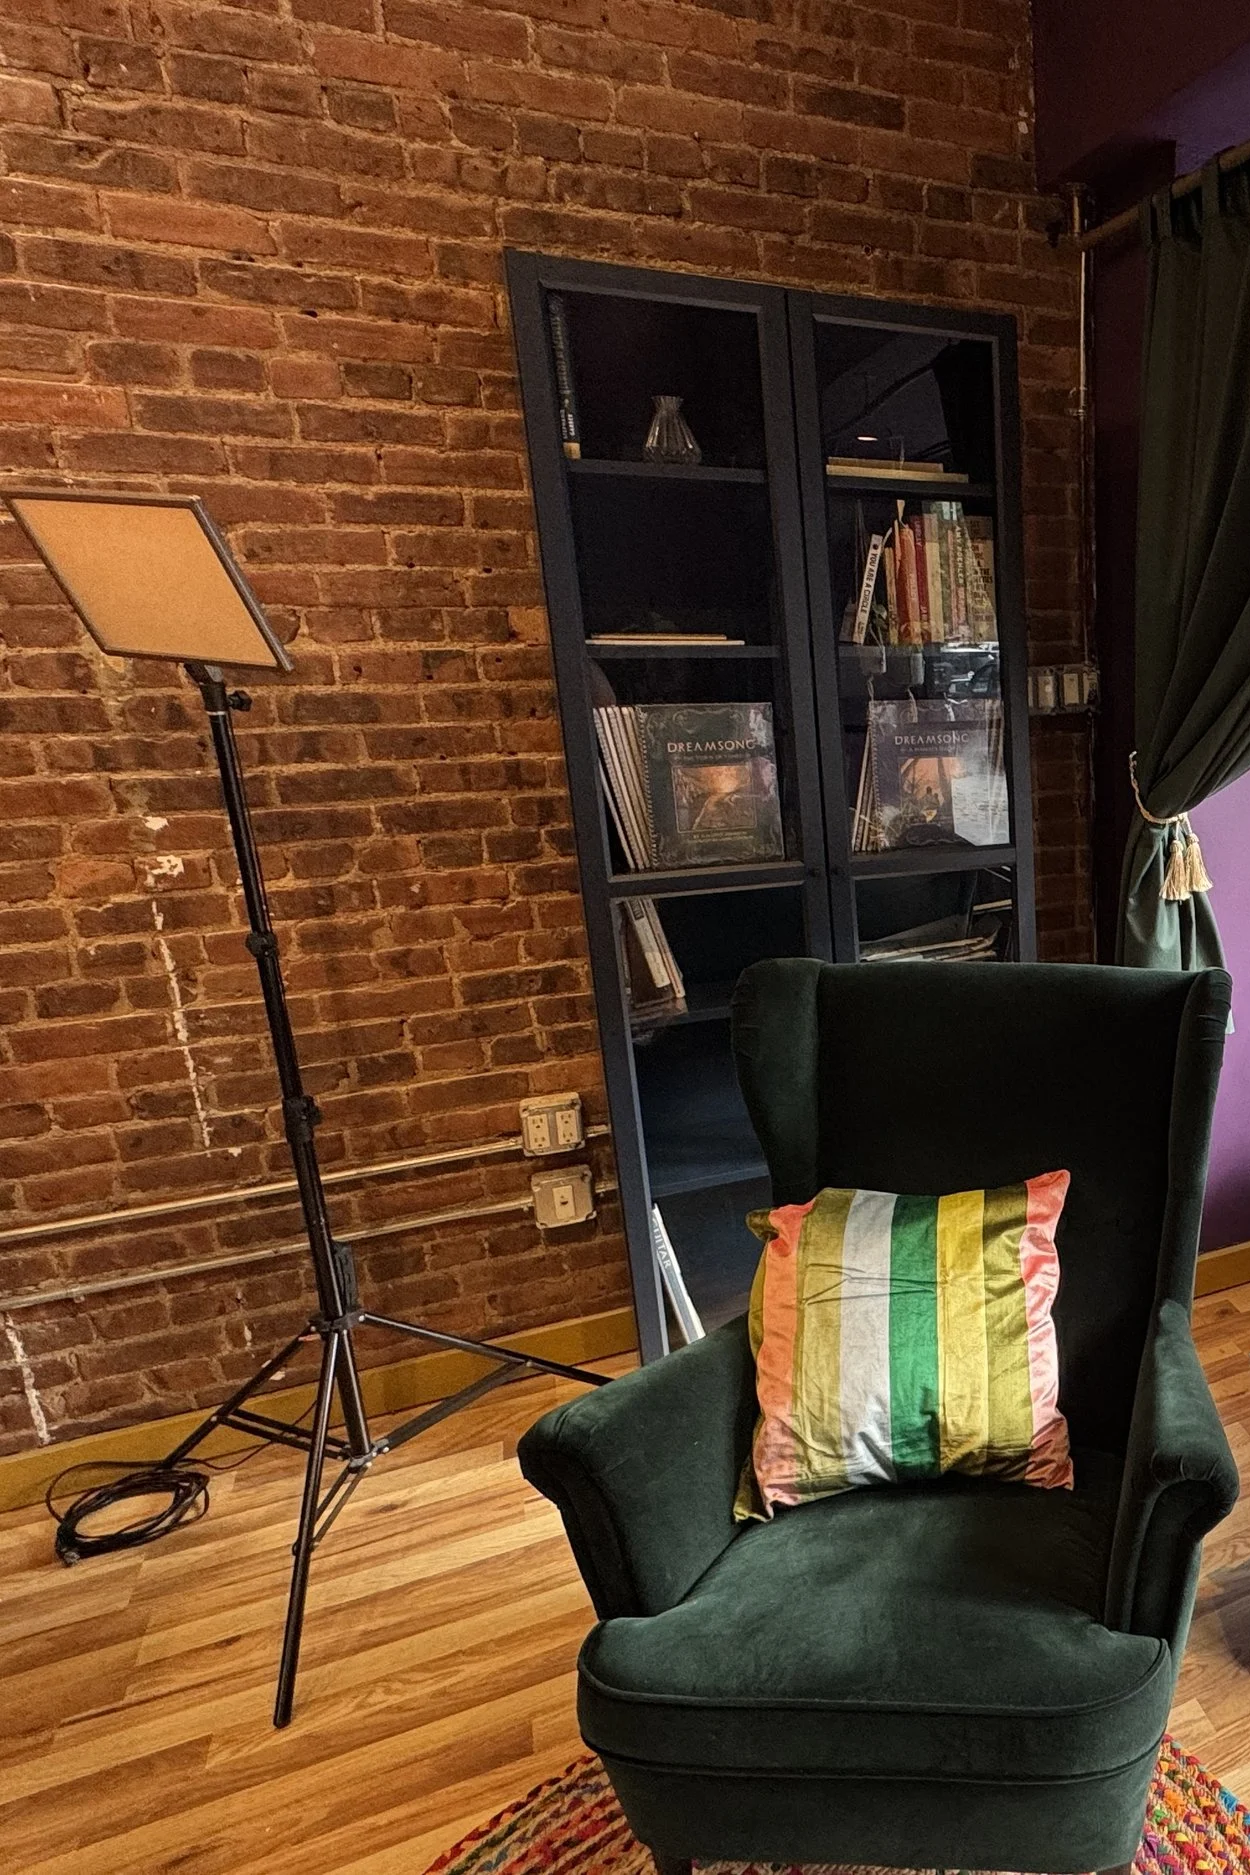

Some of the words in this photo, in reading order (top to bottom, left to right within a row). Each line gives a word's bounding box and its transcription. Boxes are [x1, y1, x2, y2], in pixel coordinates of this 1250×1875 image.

[868, 552, 879, 568] YOU
[866, 568, 875, 582] ARE
[860, 590, 871, 614] CIRCLE
